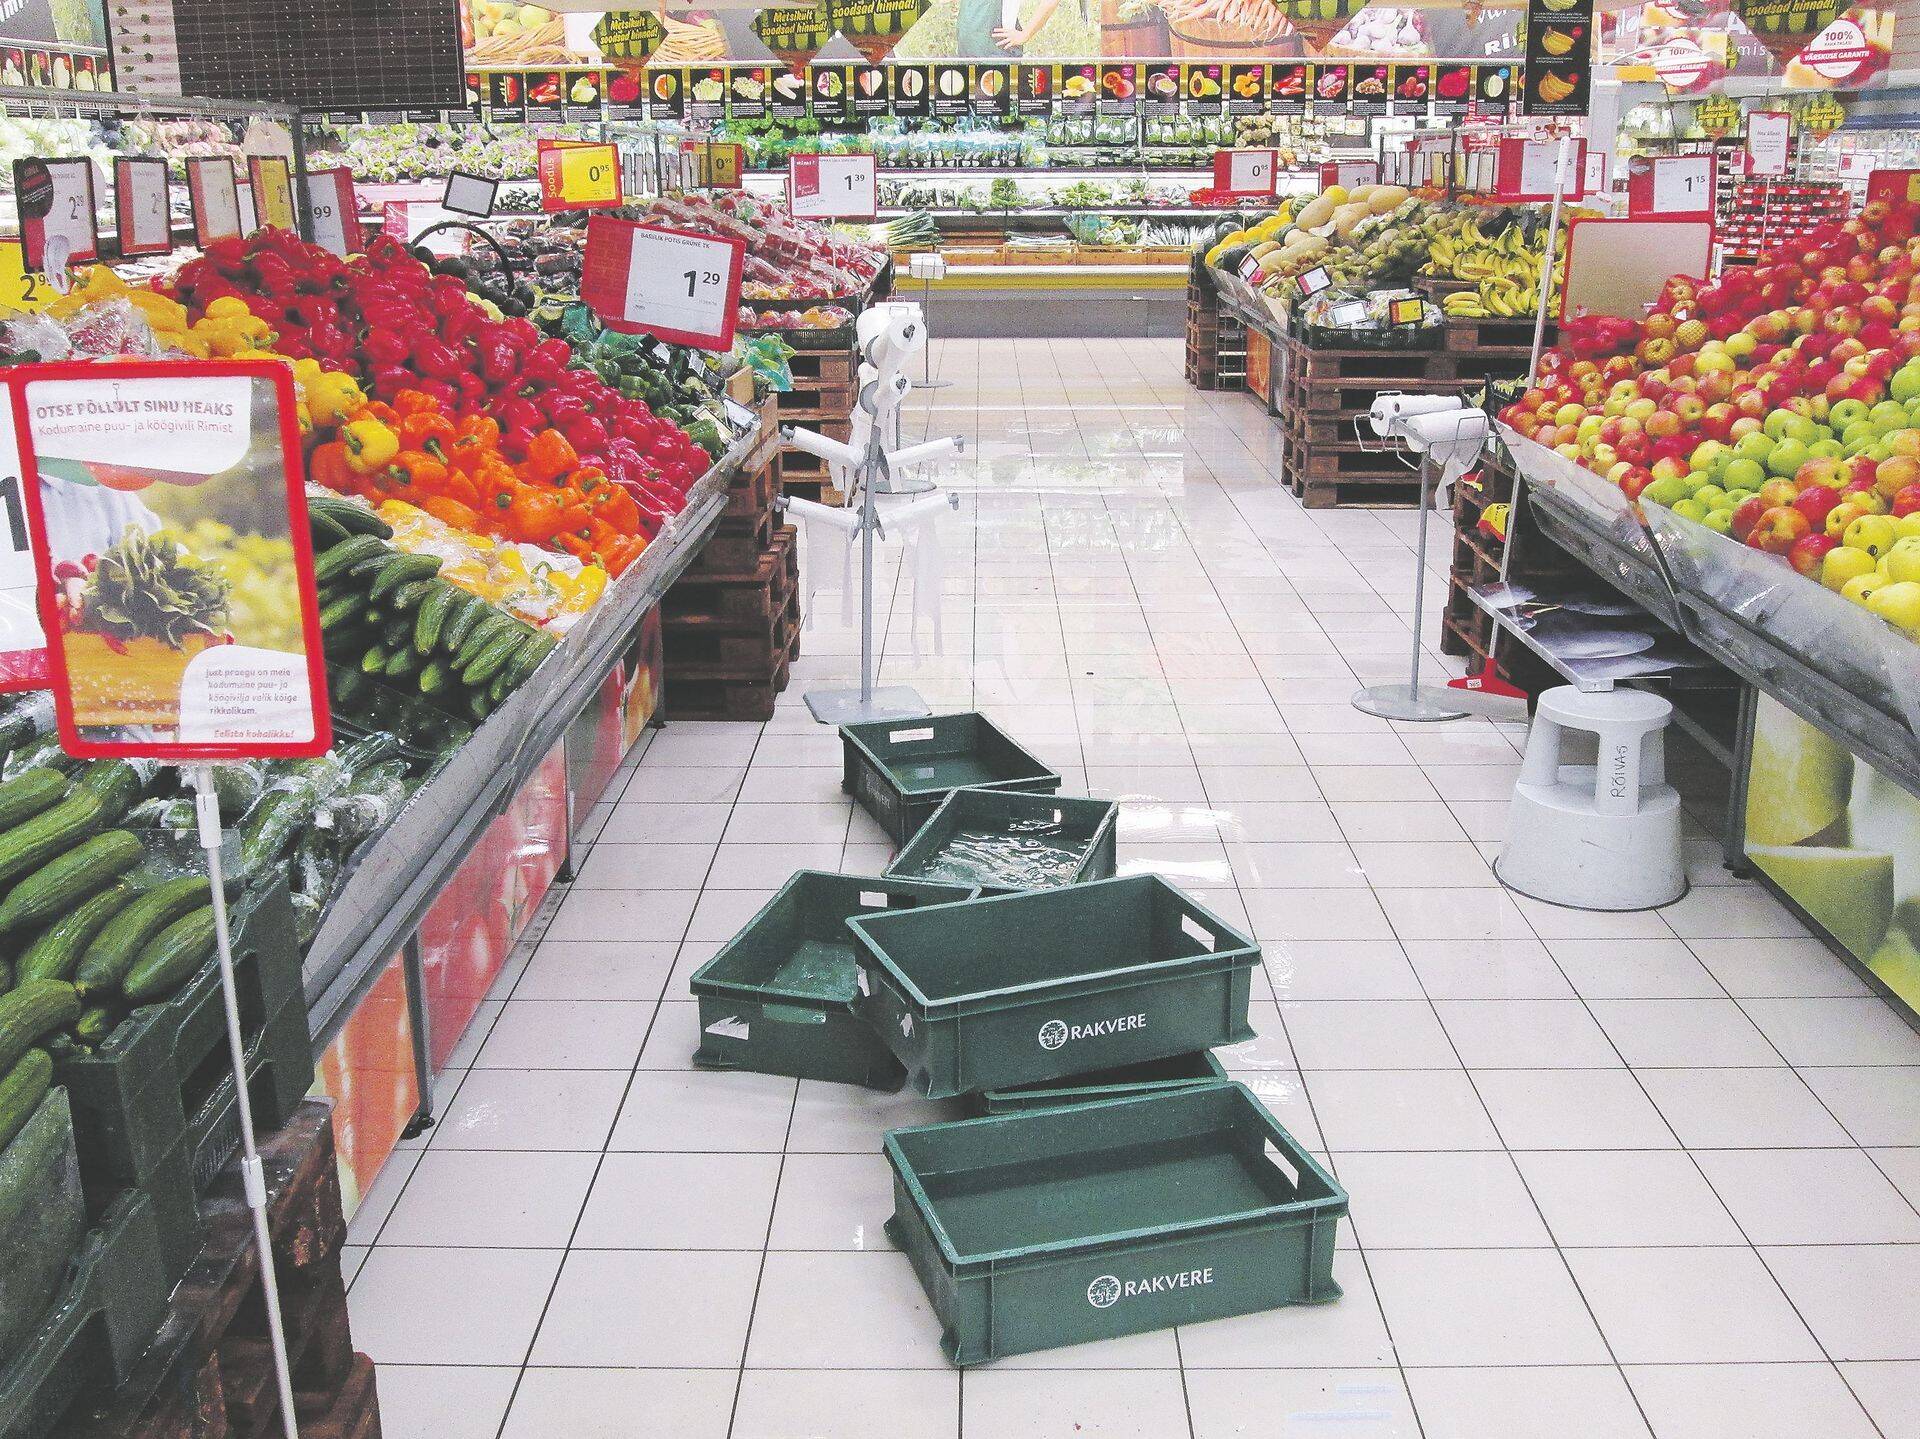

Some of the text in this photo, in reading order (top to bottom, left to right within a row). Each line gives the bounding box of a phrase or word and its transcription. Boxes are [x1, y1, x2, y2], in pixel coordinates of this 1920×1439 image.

[773, 9, 813, 23] Metsikult
[832, 3, 873, 18] soodsad
[761, 20, 828, 36] soodsad hinnad!
[1825, 31, 1853, 41] 100%
[35, 404, 74, 420] OTSE
[143, 400, 179, 413] SINU
[182, 401, 234, 417] HEAKS
[37, 421, 101, 437] Kodumaine
[133, 420, 145, 433] ja
[197, 420, 233, 434] Rimist
[224, 668, 256, 678] praegu
[270, 667, 291, 676] meie
[207, 680, 256, 689] kodumaine
[214, 729, 296, 738] Eelista kohalikku!
[1070, 1013, 1147, 1041] RAKVERE
[1124, 1267, 1214, 1297] RAKVERE
